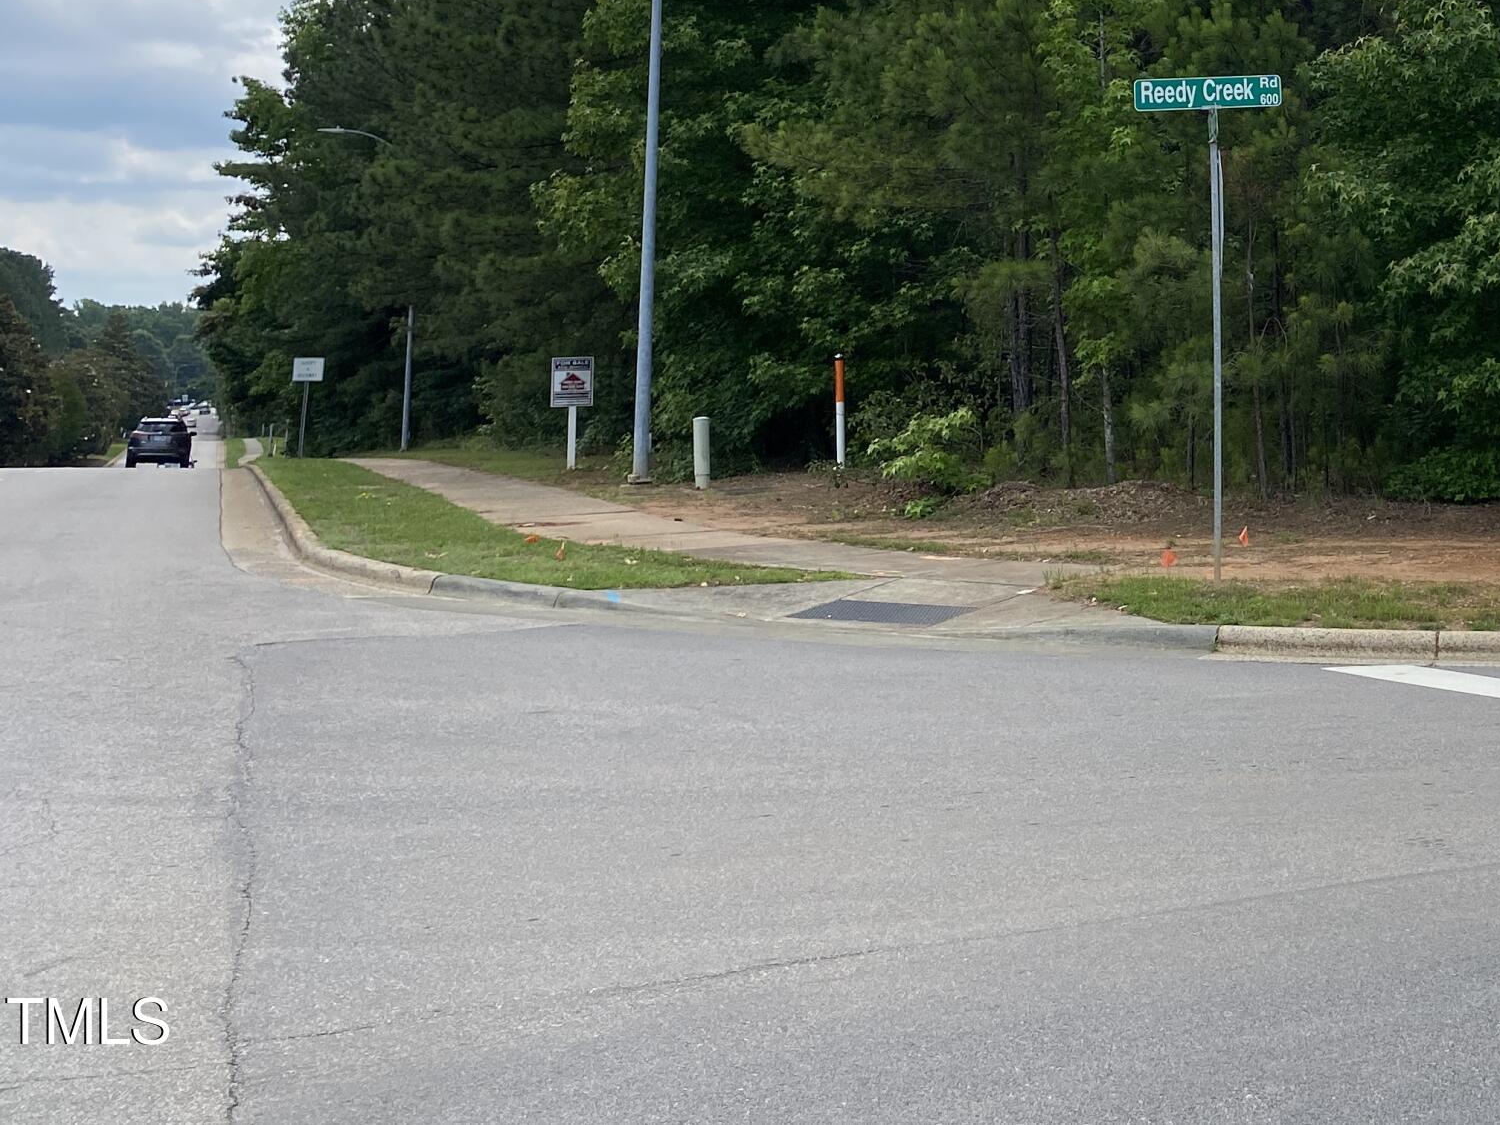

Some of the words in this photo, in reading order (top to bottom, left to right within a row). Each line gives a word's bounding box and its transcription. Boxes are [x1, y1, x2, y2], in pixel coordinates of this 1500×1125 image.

[1140, 80, 1197, 108] Reedy
[1202, 78, 1254, 102] Creek
[1259, 77, 1278, 89] Rd
[1259, 94, 1279, 105] 600
